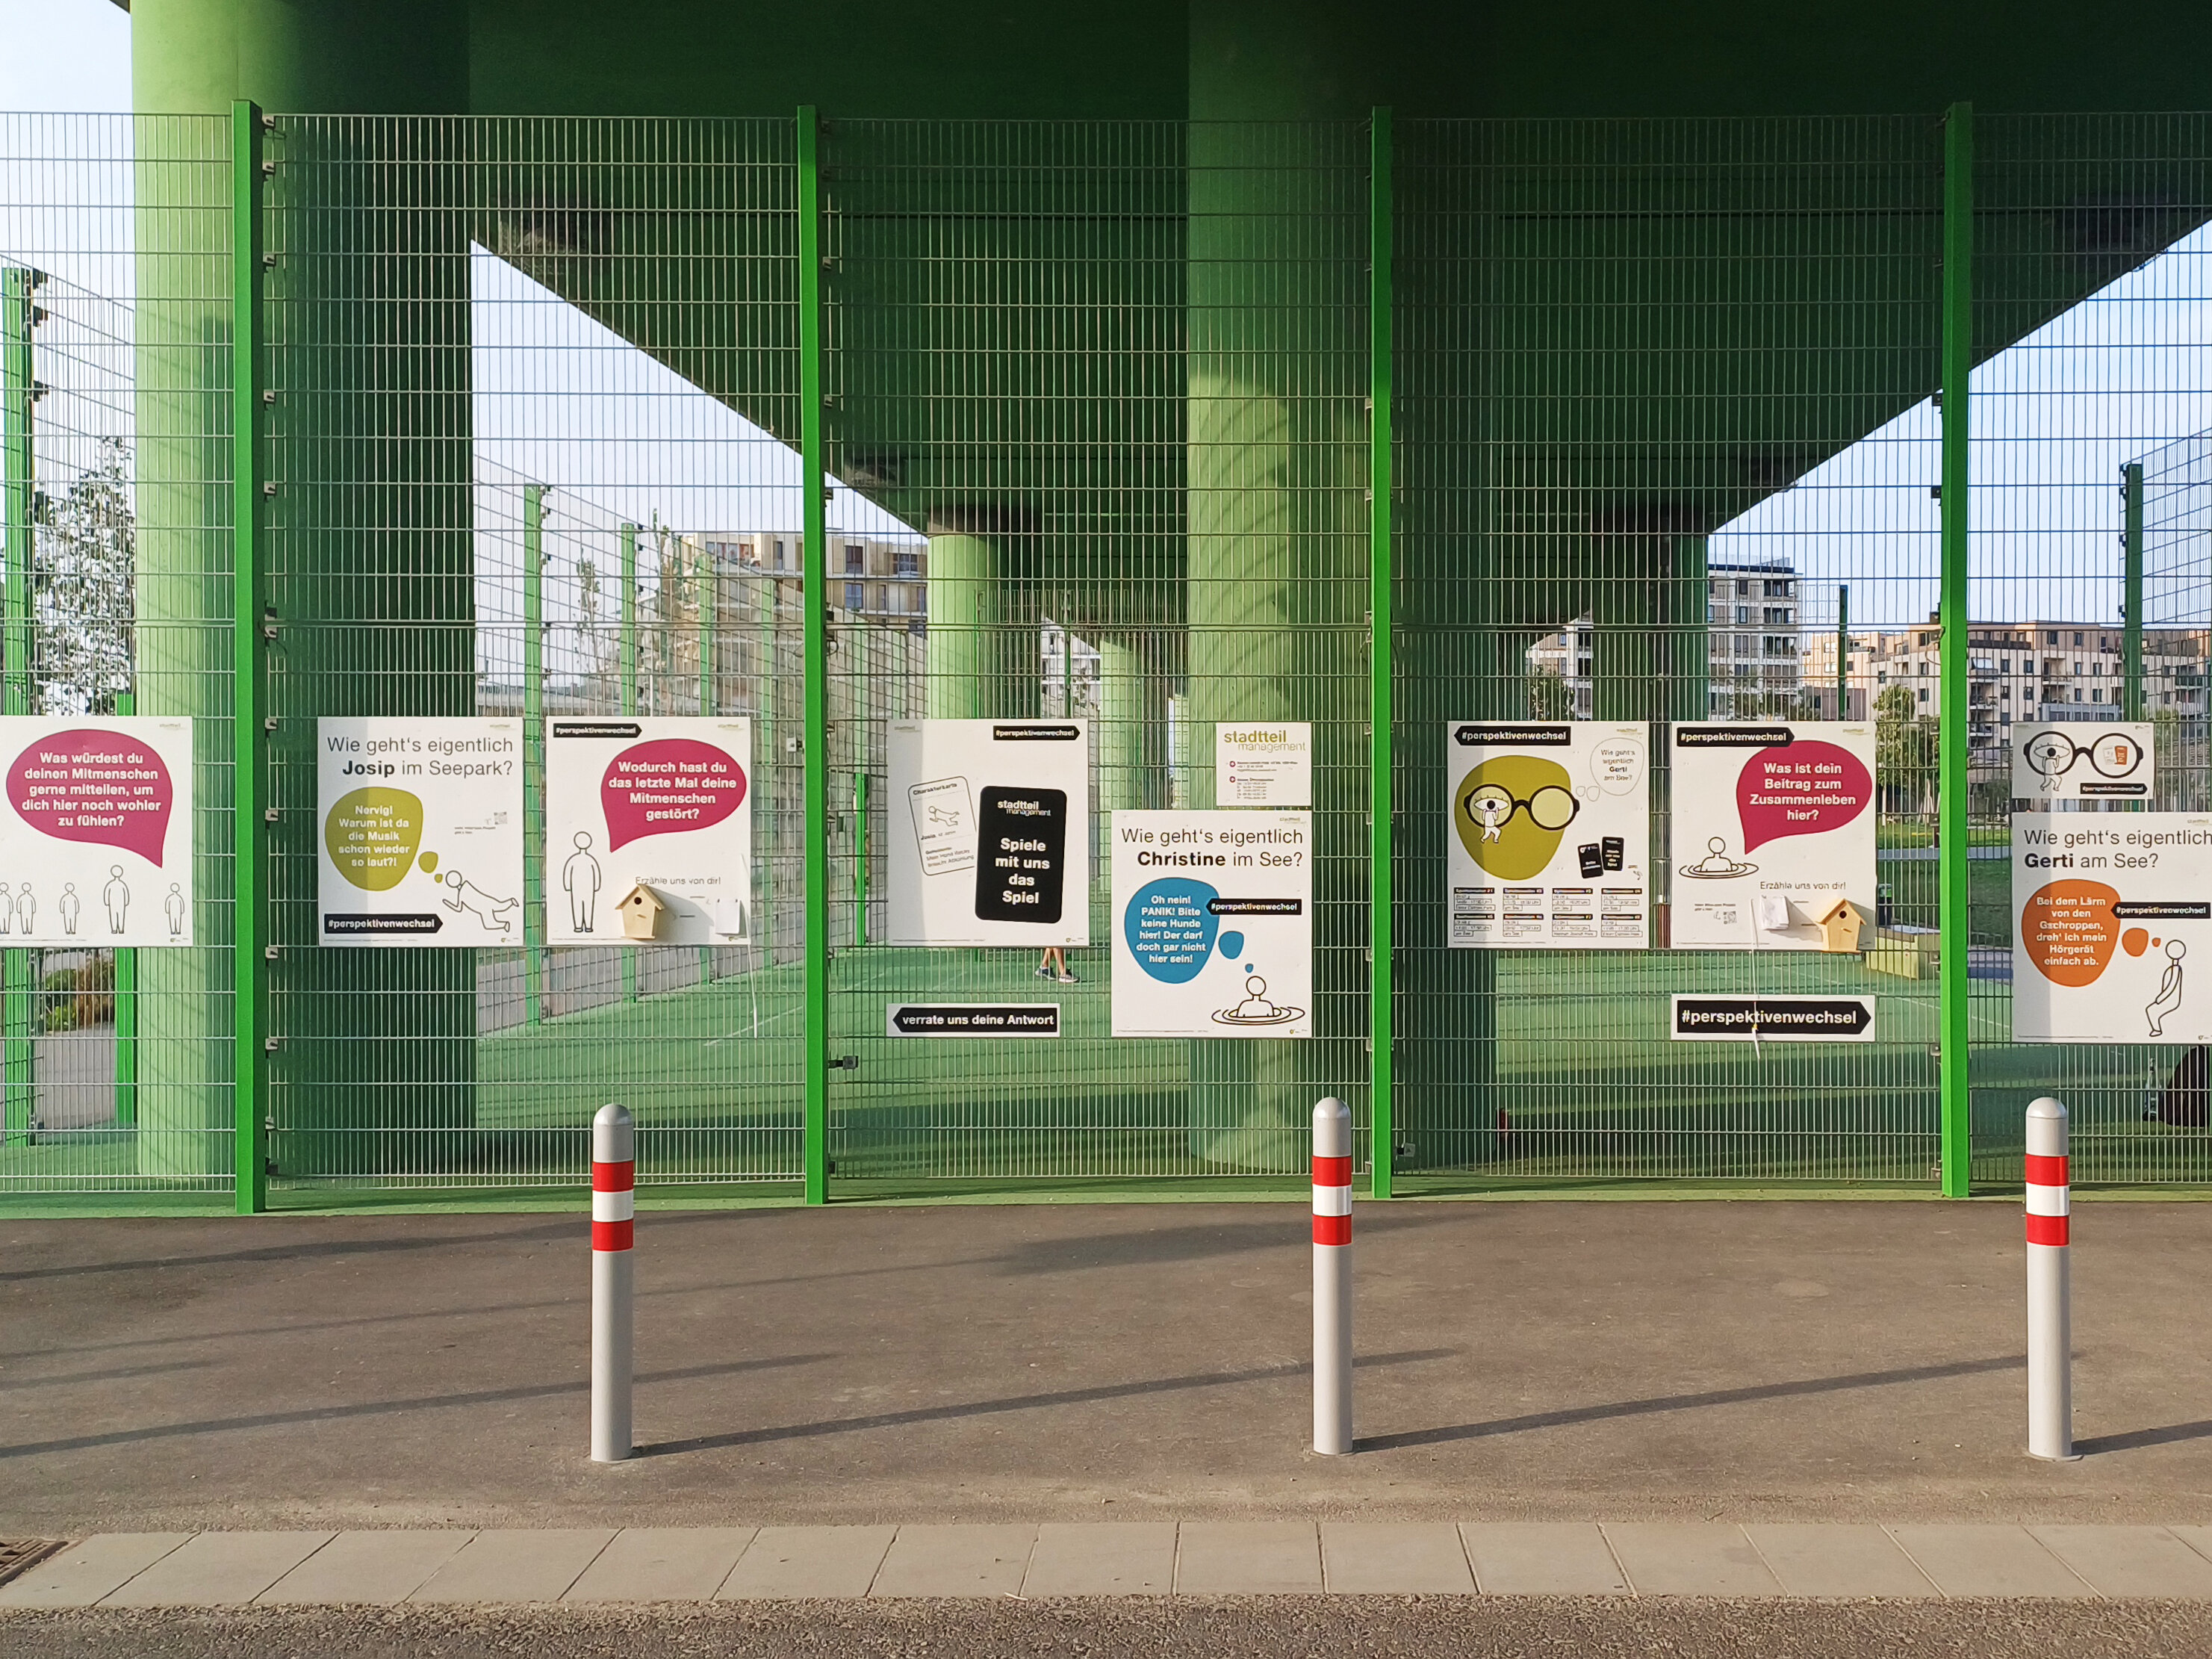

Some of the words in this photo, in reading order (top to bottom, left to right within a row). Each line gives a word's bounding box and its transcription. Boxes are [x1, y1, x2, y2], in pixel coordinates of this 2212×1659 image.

[1224, 730, 1286, 742] stadtteil
[1462, 732, 1566, 740] #perspektivenwechsel
[1680, 733, 1786, 742] #perspektivenwechsel
[328, 737, 361, 752] Wie
[428, 737, 513, 755] eigentlich
[1238, 742, 1305, 753] management
[40, 752, 67, 764] Was
[72, 752, 124, 764] würdest
[128, 752, 143, 764] du
[343, 760, 395, 778] Josip
[403, 760, 422, 775] im
[429, 760, 512, 778] Seepark?
[618, 762, 676, 773] Wodurch
[679, 762, 707, 773] hast
[711, 762, 727, 773] du
[1764, 763, 1792, 774] Was
[1795, 763, 1812, 774] ist
[1815, 763, 1842, 774] dein
[25, 769, 67, 779] deinen
[72, 768, 158, 779] Mitmenschen
[609, 778, 632, 788] das
[636, 778, 671, 788] letzte
[675, 778, 698, 788] Mal
[701, 778, 736, 788] deine
[1765, 778, 1812, 791] Beitrag
[1815, 781, 1842, 790] zum
[29, 786, 66, 796] gerne
[70, 784, 129, 796] mitteilen,
[134, 786, 153, 795] um
[630, 793, 715, 804] Mitmenschen
[1750, 794, 1857, 805] Zusammenleben
[22, 799, 49, 810] dich
[53, 799, 78, 810] hier
[81, 799, 113, 810] noch
[117, 799, 161, 810] wohler
[998, 800, 1039, 810] stadtteil
[58, 816, 73, 826] zu
[77, 815, 124, 826] fühlen?
[646, 809, 699, 822] gestört?
[1787, 810, 1819, 820] hier?
[339, 819, 376, 828] Warum
[379, 819, 393, 828] ist
[396, 819, 409, 828] da
[349, 831, 364, 841] die
[367, 831, 400, 841] Musik
[1122, 828, 1154, 843] Wie
[1220, 828, 1303, 846] eigentlich
[2025, 830, 2057, 845] Wie
[2127, 830, 2212, 848] eigentlich
[338, 844, 371, 854] schon
[373, 844, 409, 854] wieder
[1001, 838, 1046, 852] Spiele
[352, 859, 364, 867] so
[995, 856, 1019, 869] mit
[1023, 858, 1050, 869] uns
[1137, 852, 1225, 866] Christine
[1233, 852, 1253, 866] im
[1259, 852, 1302, 866] See?
[2025, 853, 2074, 868] Gerti
[2081, 855, 2107, 868] am
[2114, 853, 2158, 868] See?
[1009, 873, 1035, 886] das
[1795, 882, 1810, 890] uns
[1813, 882, 1829, 890] von
[1002, 890, 1039, 905] Spiel
[1151, 896, 1165, 904] Oh
[1167, 896, 1191, 905] nein!
[2037, 897, 2053, 905] Bei
[2056, 897, 2078, 905] dem
[2081, 896, 2105, 905] Lärm
[1141, 908, 1175, 916] PANIK!
[1178, 908, 1201, 917] Bitte
[1211, 903, 1297, 912] #perspektivenwechsel
[2116, 906, 2206, 915] #perspektivenwechsel
[2051, 909, 2069, 918] von
[2072, 909, 2091, 918] den
[329, 919, 435, 929] #perspektivenwechsel
[1141, 919, 1167, 928] keine
[1170, 919, 1201, 928] Hunde
[2039, 920, 2104, 931] Gschroppen,
[1164, 931, 1181, 940] Der
[1184, 930, 1202, 940] darf
[2065, 933, 2080, 942] ich
[2082, 933, 2107, 942] mein
[1137, 943, 1161, 952] doch
[1164, 943, 1179, 953] gar
[1181, 942, 1206, 952] nicht
[2050, 944, 2094, 955] Hörgerät
[1149, 955, 1168, 964] hier
[1170, 954, 1193, 964] sein!
[2045, 957, 2081, 966] einfach
[2084, 957, 2098, 966] ab.
[903, 1016, 944, 1026] verrate
[947, 1016, 969, 1026] uns
[972, 1014, 1004, 1026] deine
[1007, 1014, 1054, 1026] Antwort
[1682, 1010, 1857, 1026] #perspektivenwechsel
